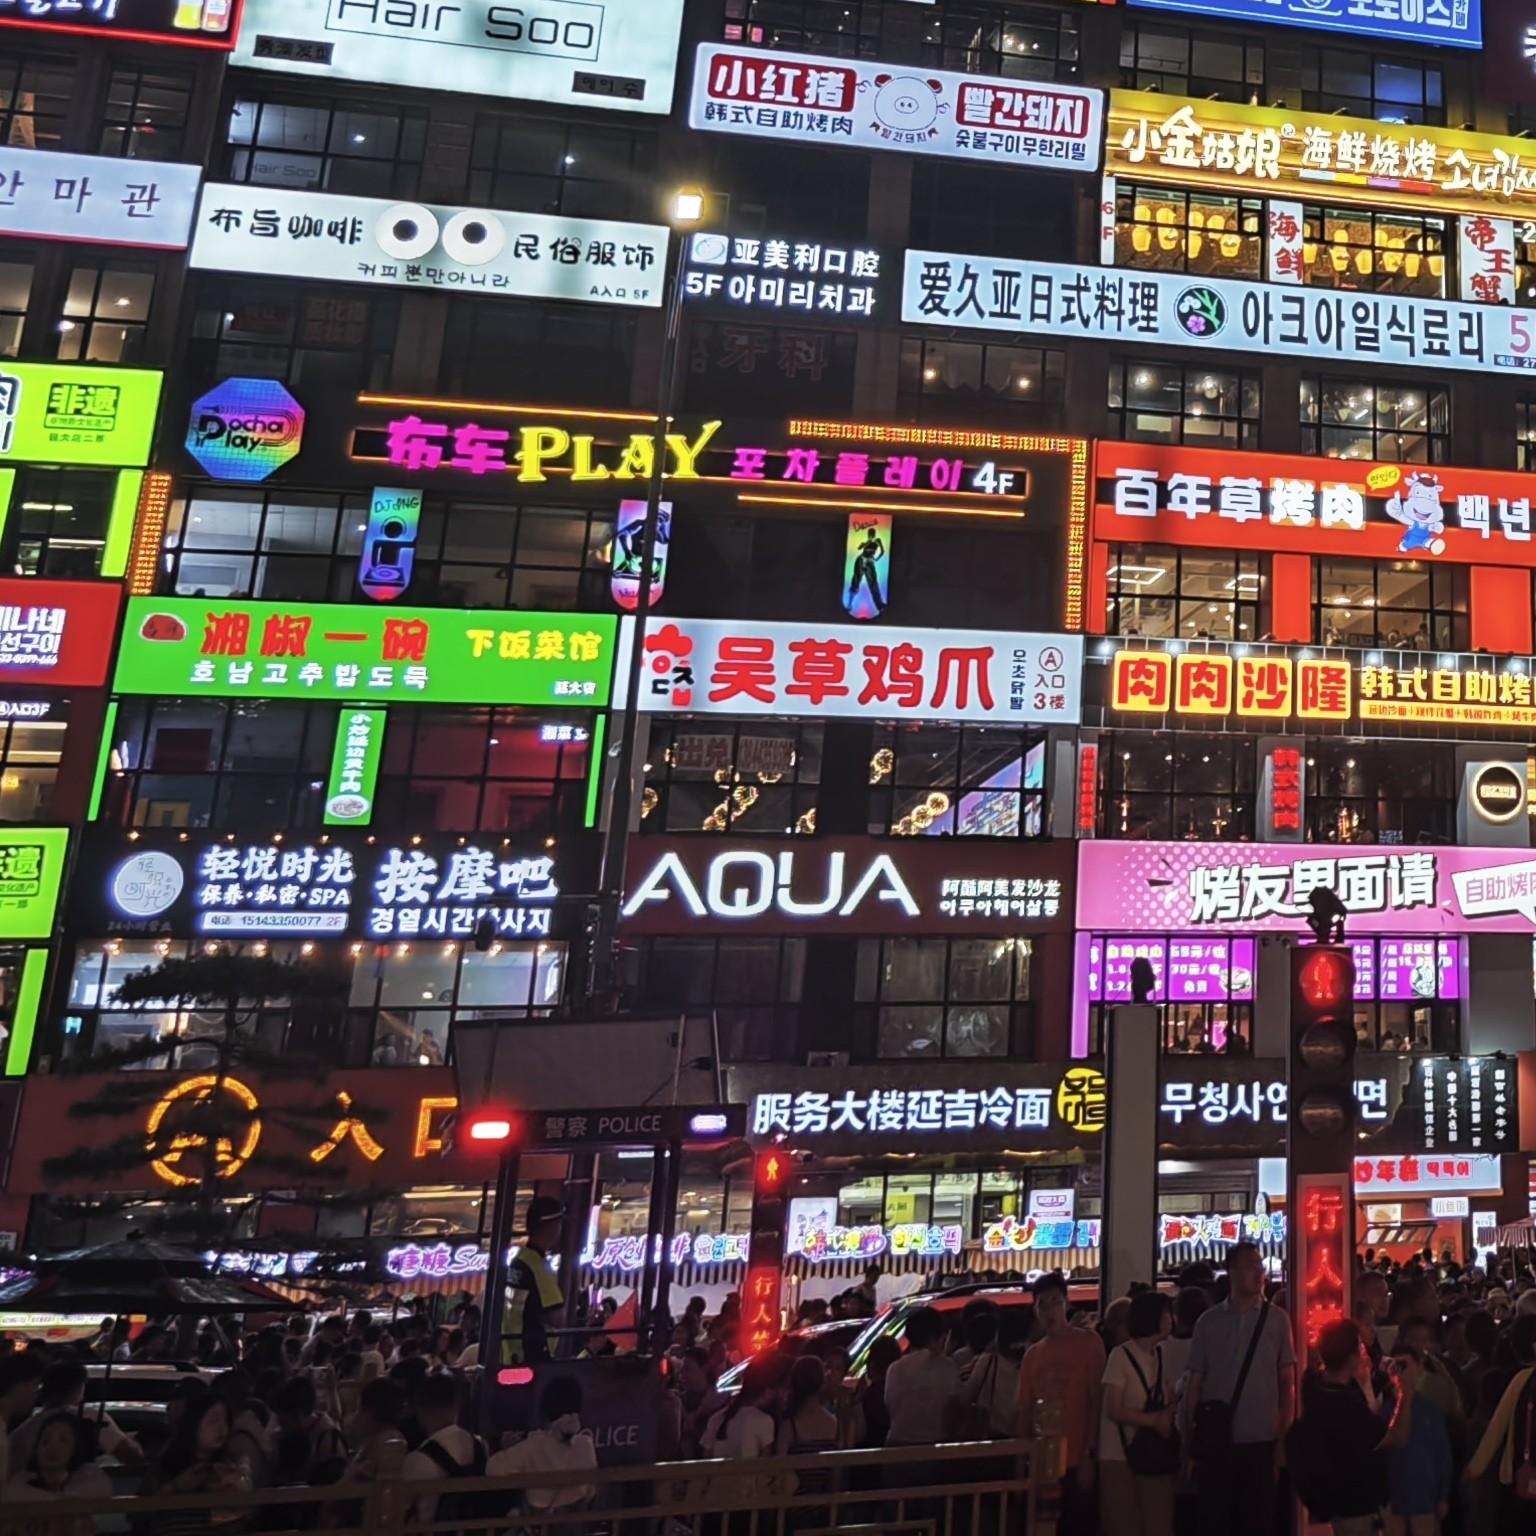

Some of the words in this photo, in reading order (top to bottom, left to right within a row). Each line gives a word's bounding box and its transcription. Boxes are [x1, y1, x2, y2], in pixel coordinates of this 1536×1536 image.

[485, 6, 593, 49] Soo
[713, 59, 847, 107] 小红猪
[703, 101, 854, 137] 韩式自助烤肉
[962, 86, 1085, 136] 빨간돼지
[955, 128, 1087, 162] 숯불구이무한리필
[1122, 105, 1283, 181] 小金姑娘
[1302, 125, 1438, 182] 海鲜烧烤
[209, 208, 364, 246] 布旨咖啡
[514, 232, 655, 272] 民俗服饰
[732, 238, 882, 280] 亚美利口腔
[1269, 211, 1303, 280] 海鲜
[686, 273, 724, 297] 5F
[729, 275, 877, 316] 아미리치과
[919, 259, 1161, 334] 爱久亚日式料理
[1242, 289, 1485, 363] 아크아일식료리
[50, 383, 118, 415] 非遗
[387, 416, 510, 474] 布车
[516, 420, 723, 483] PLAY
[731, 447, 963, 493] 포차플레이
[972, 461, 1014, 495] 4F
[1114, 467, 1366, 532] 百年草烤肉
[199, 612, 430, 662] 湘椒一碗
[466, 629, 603, 663] 下饭菜馆
[708, 636, 995, 712] 吴草鸡爪
[1033, 673, 1066, 689] 入口
[1118, 657, 1348, 713] 肉肉沙隆
[1033, 693, 1065, 711] 3楼
[202, 845, 356, 883] 轻悦时光
[376, 846, 560, 903] 按摩吧
[622, 850, 921, 917] AQUA
[1189, 852, 1438, 923] 烤友里面请
[598, 1114, 663, 1134] POLICE
[753, 1087, 1053, 1134] 服务大楼延吉冷面
